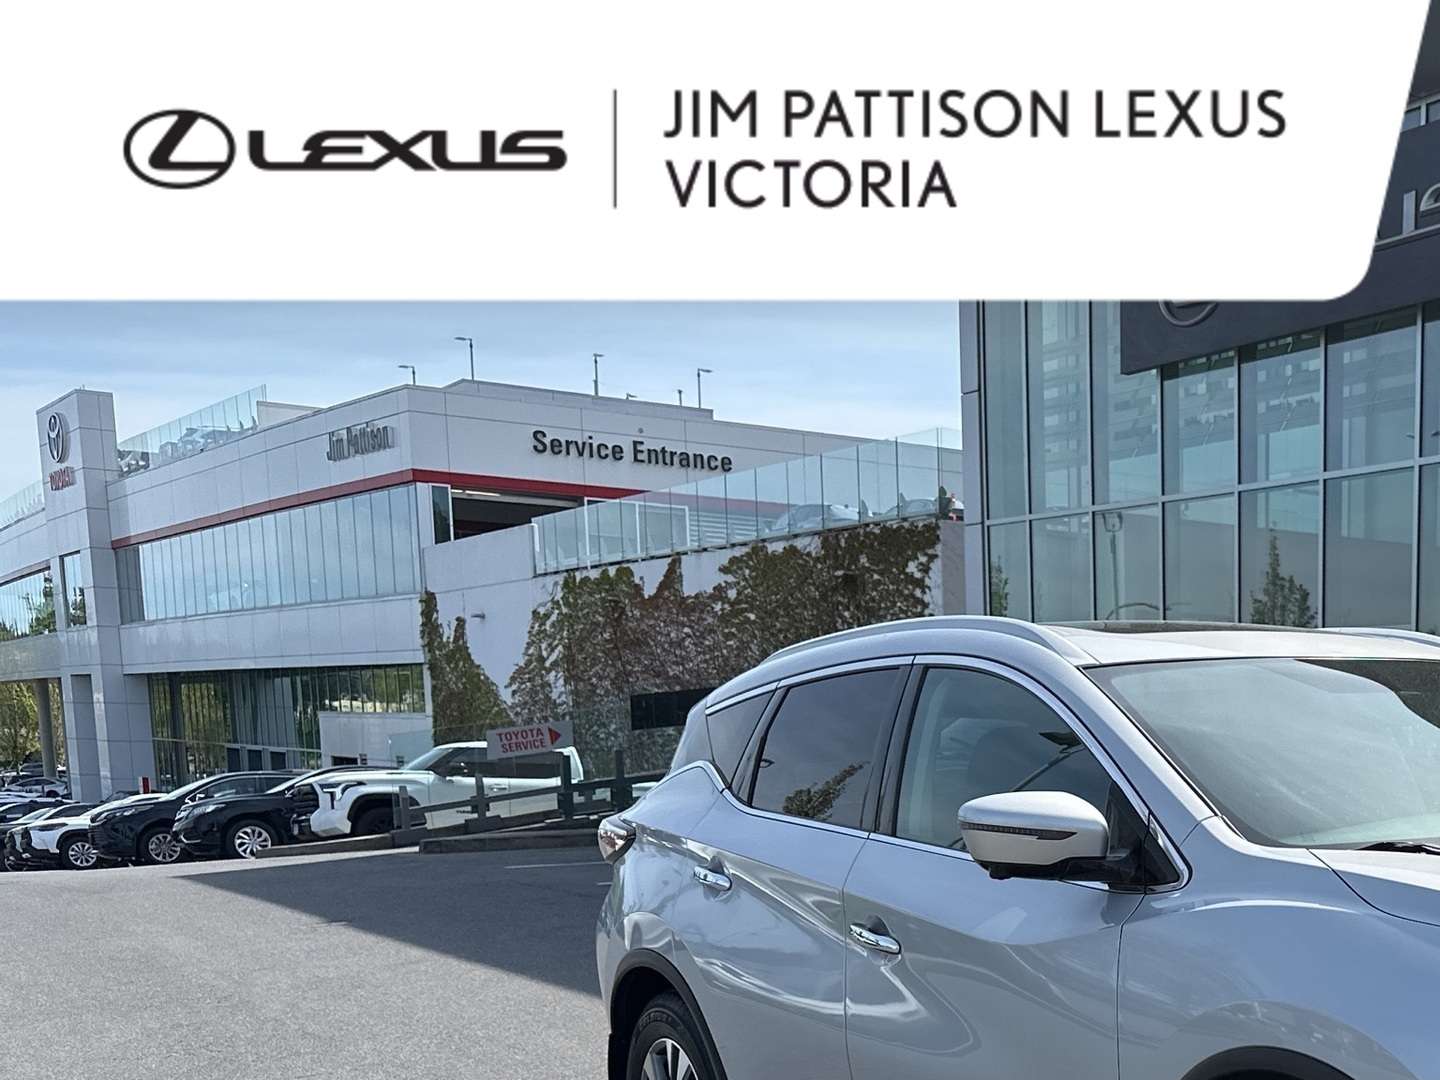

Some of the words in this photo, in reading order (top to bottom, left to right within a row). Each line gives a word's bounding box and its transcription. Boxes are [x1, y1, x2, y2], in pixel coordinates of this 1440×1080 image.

[532, 430, 625, 461] Service
[631, 440, 733, 472] Entrance
[496, 727, 544, 742] TOYOTA
[501, 738, 547, 754] SERVICE
